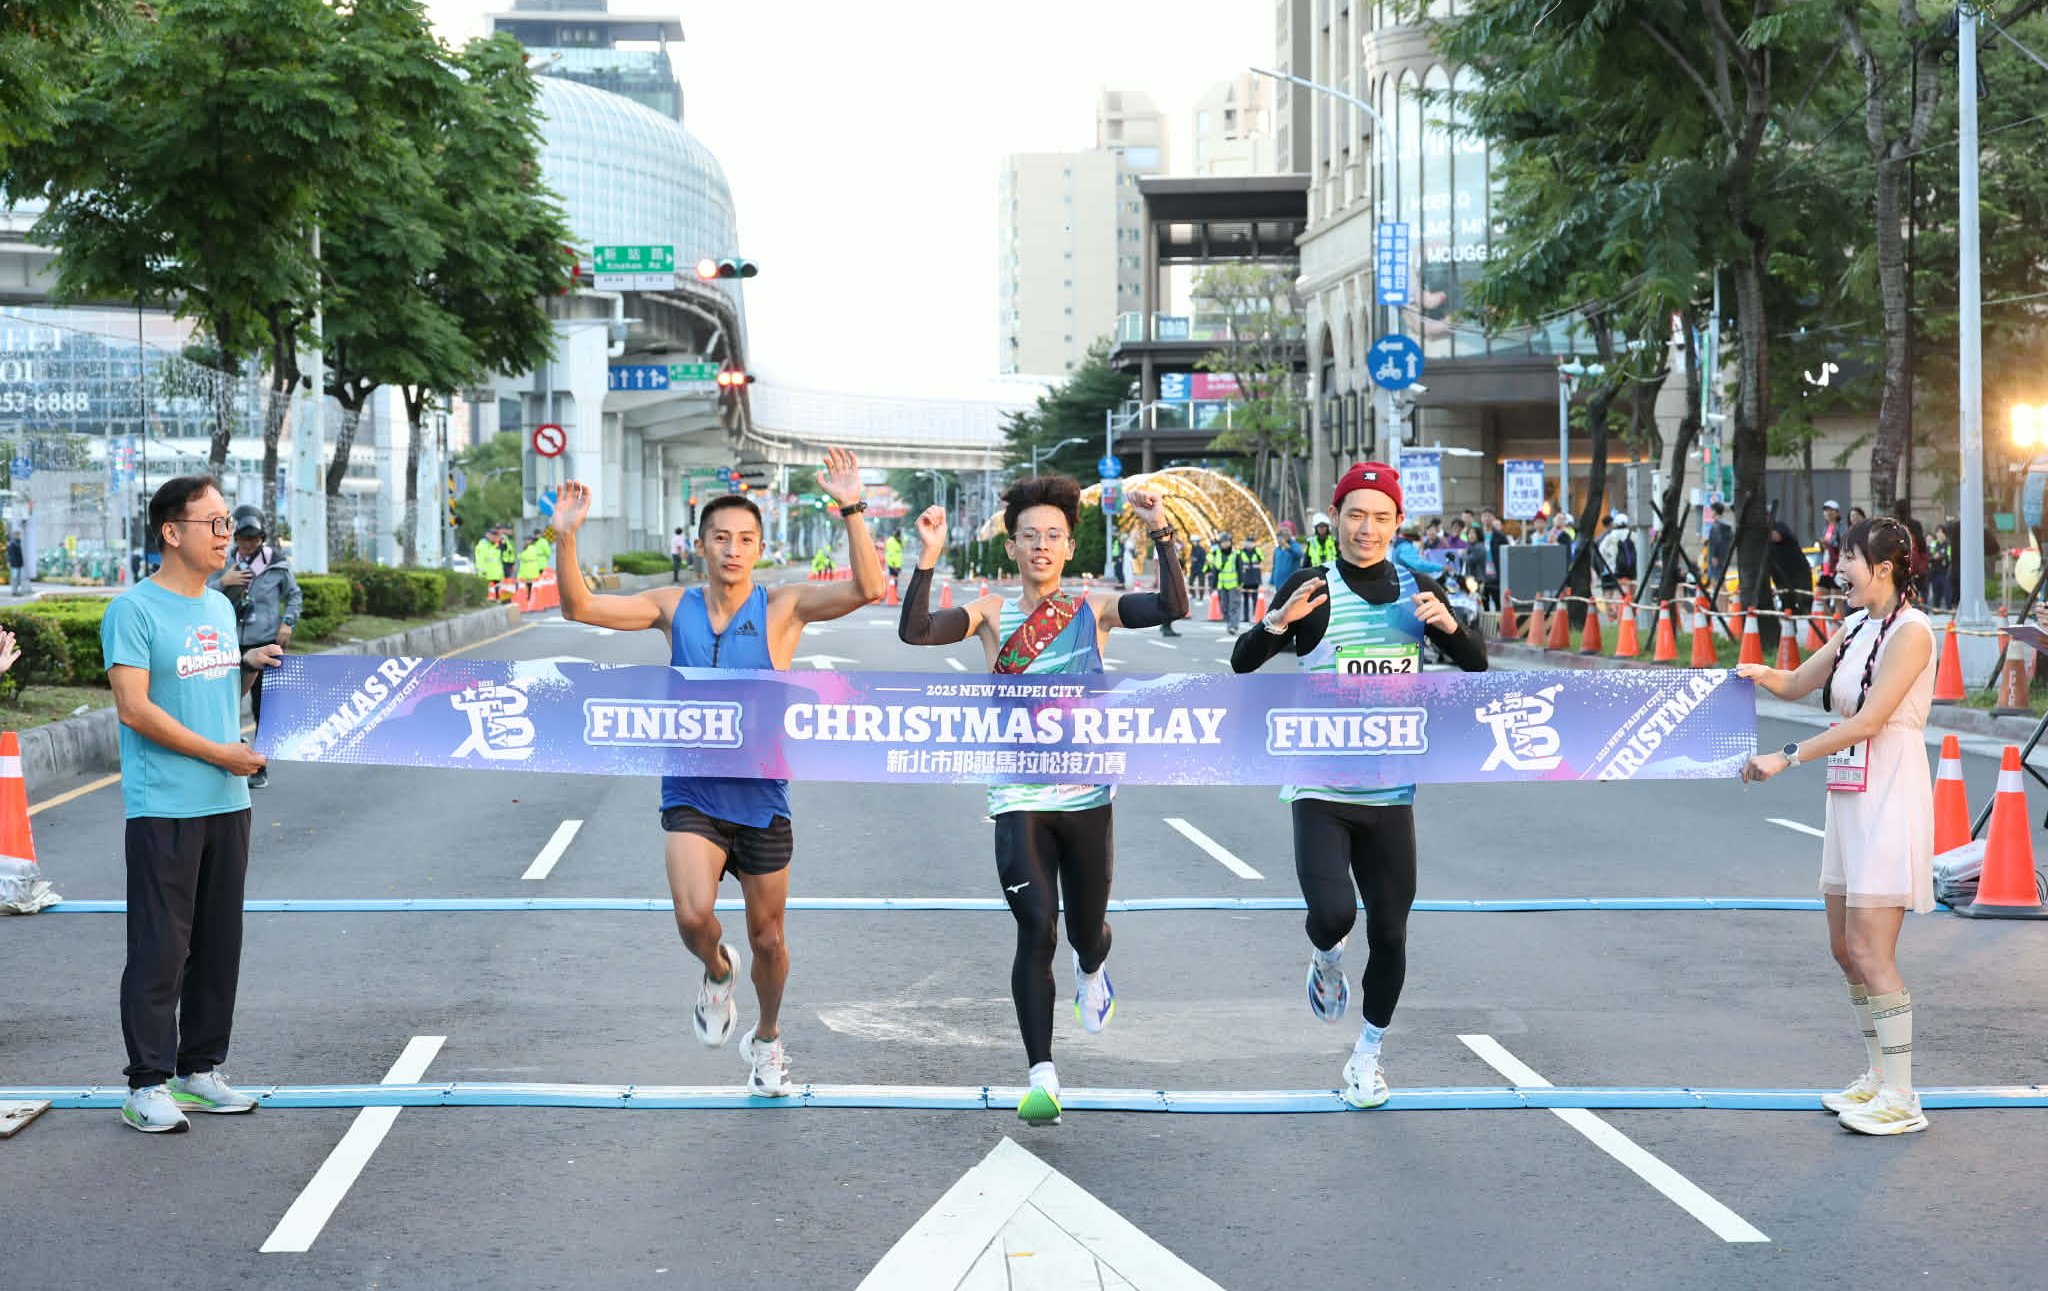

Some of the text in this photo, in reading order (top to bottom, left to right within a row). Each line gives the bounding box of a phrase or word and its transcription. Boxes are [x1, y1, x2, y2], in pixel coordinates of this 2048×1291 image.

[1347, 659, 1411, 676] 006-2
[926, 685, 1083, 698] 2025 NEW TAIPEI CITY
[591, 706, 736, 740] FINISH
[784, 704, 1227, 744] CHRISTMAS RELAY
[1274, 715, 1420, 747] FINISH
[887, 750, 1128, 774] 新北市耶誕馬拉松接力賽
